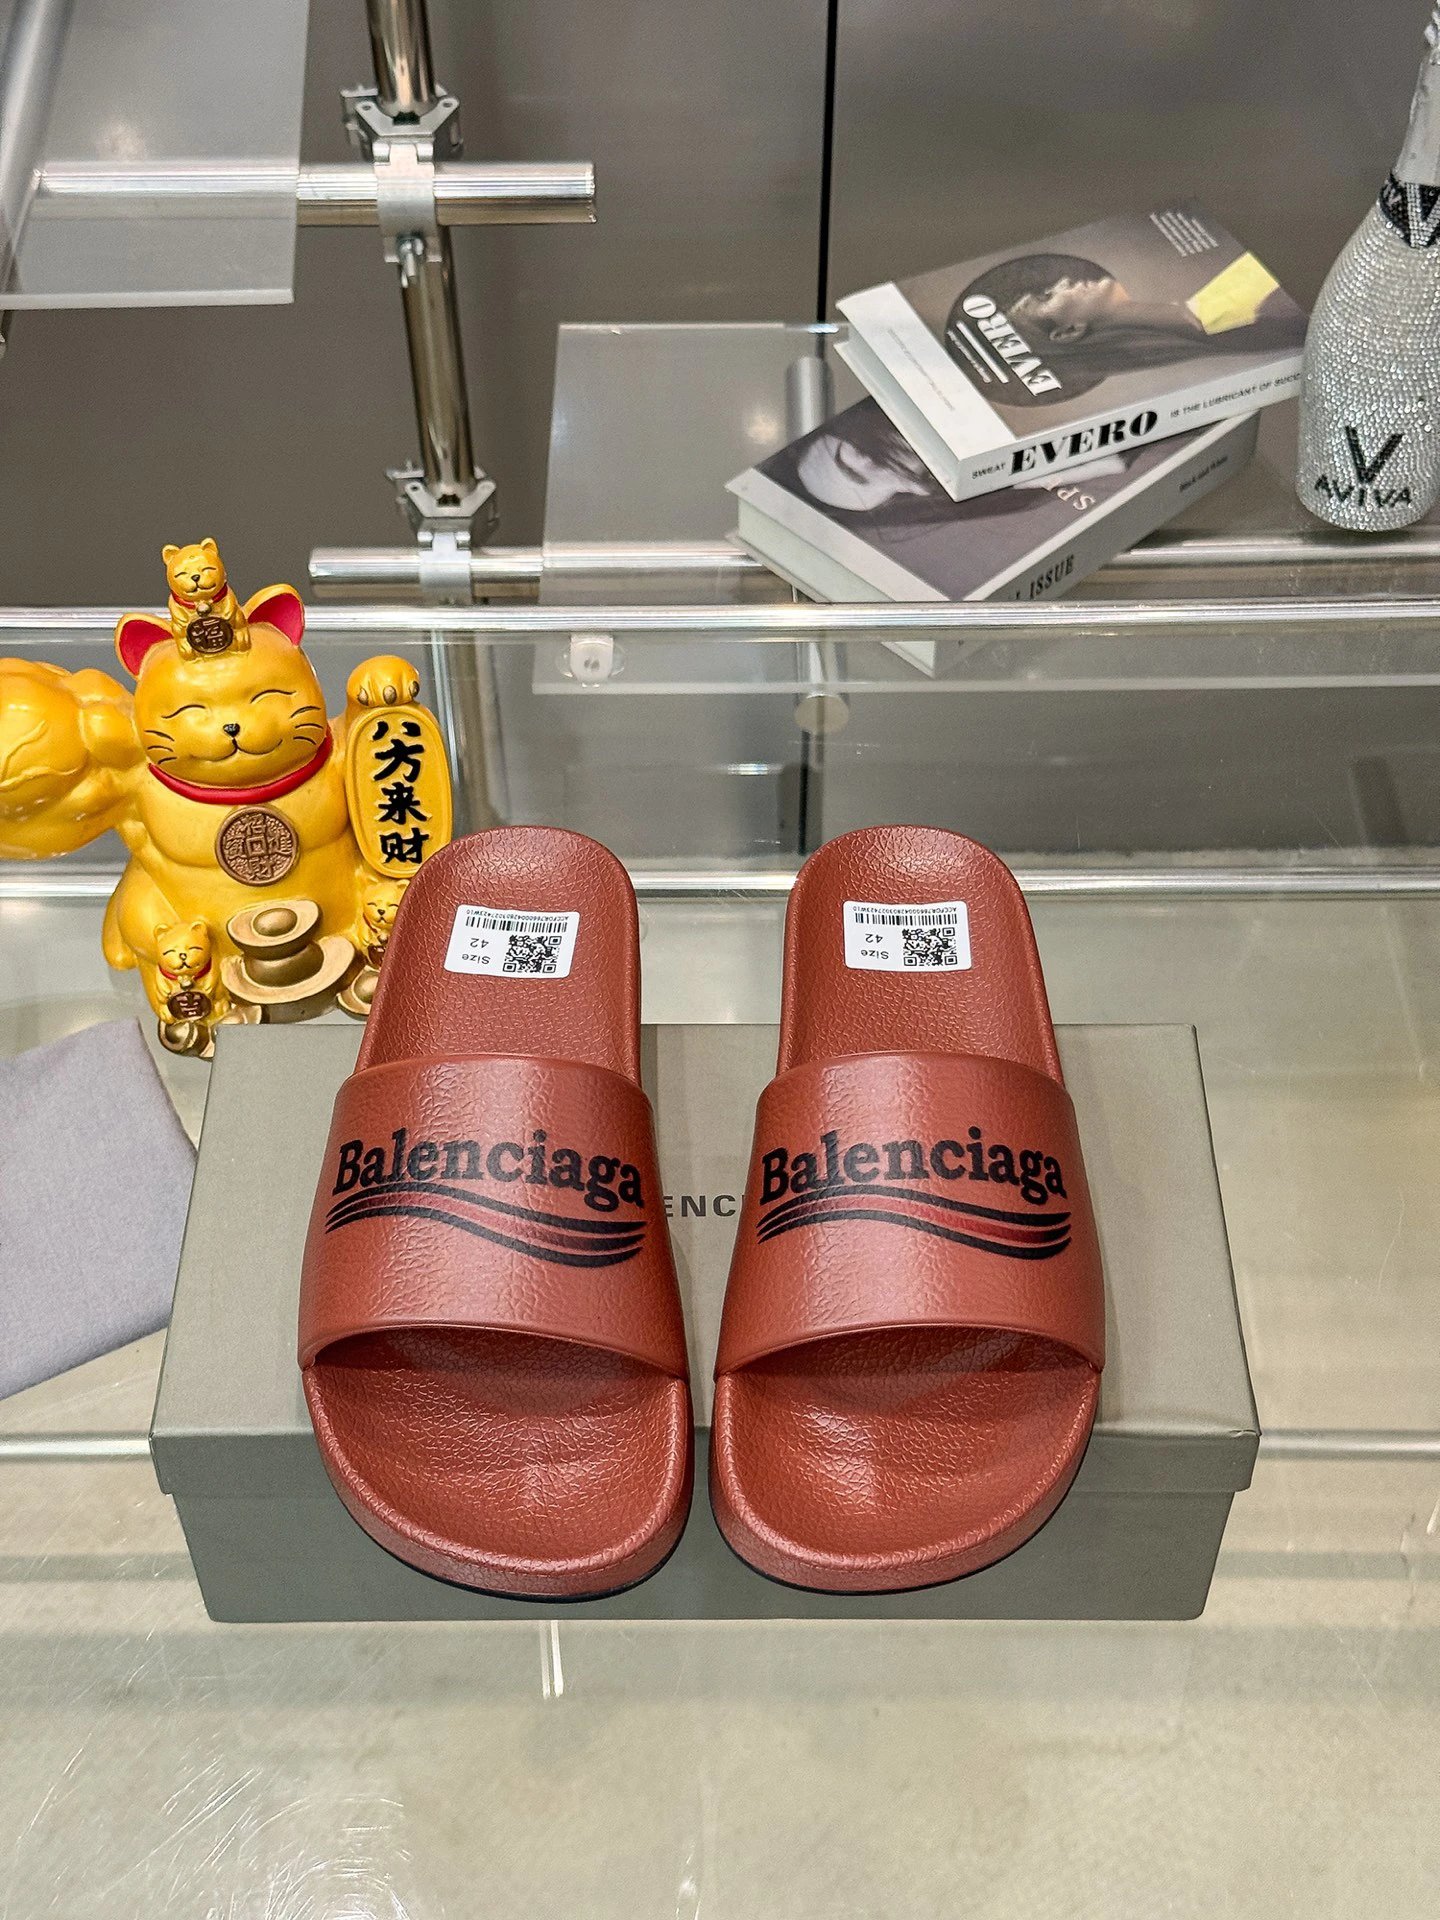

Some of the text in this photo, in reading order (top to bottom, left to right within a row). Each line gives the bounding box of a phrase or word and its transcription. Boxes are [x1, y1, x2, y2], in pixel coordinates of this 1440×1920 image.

[962, 295, 1062, 397] EVERO
[1009, 410, 1158, 476] EVERO
[1314, 475, 1412, 508] AVIVA
[1029, 553, 1075, 600] ISSUE
[372, 720, 432, 865] 八方来财
[469, 937, 490, 949] 42
[860, 949, 889, 960] Size
[864, 933, 884, 944] 42
[461, 952, 491, 966] Size
[332, 1127, 643, 1213] Balenciaga
[760, 1126, 1068, 1205] Balenciaga
[662, 1194, 747, 1218] ENC
